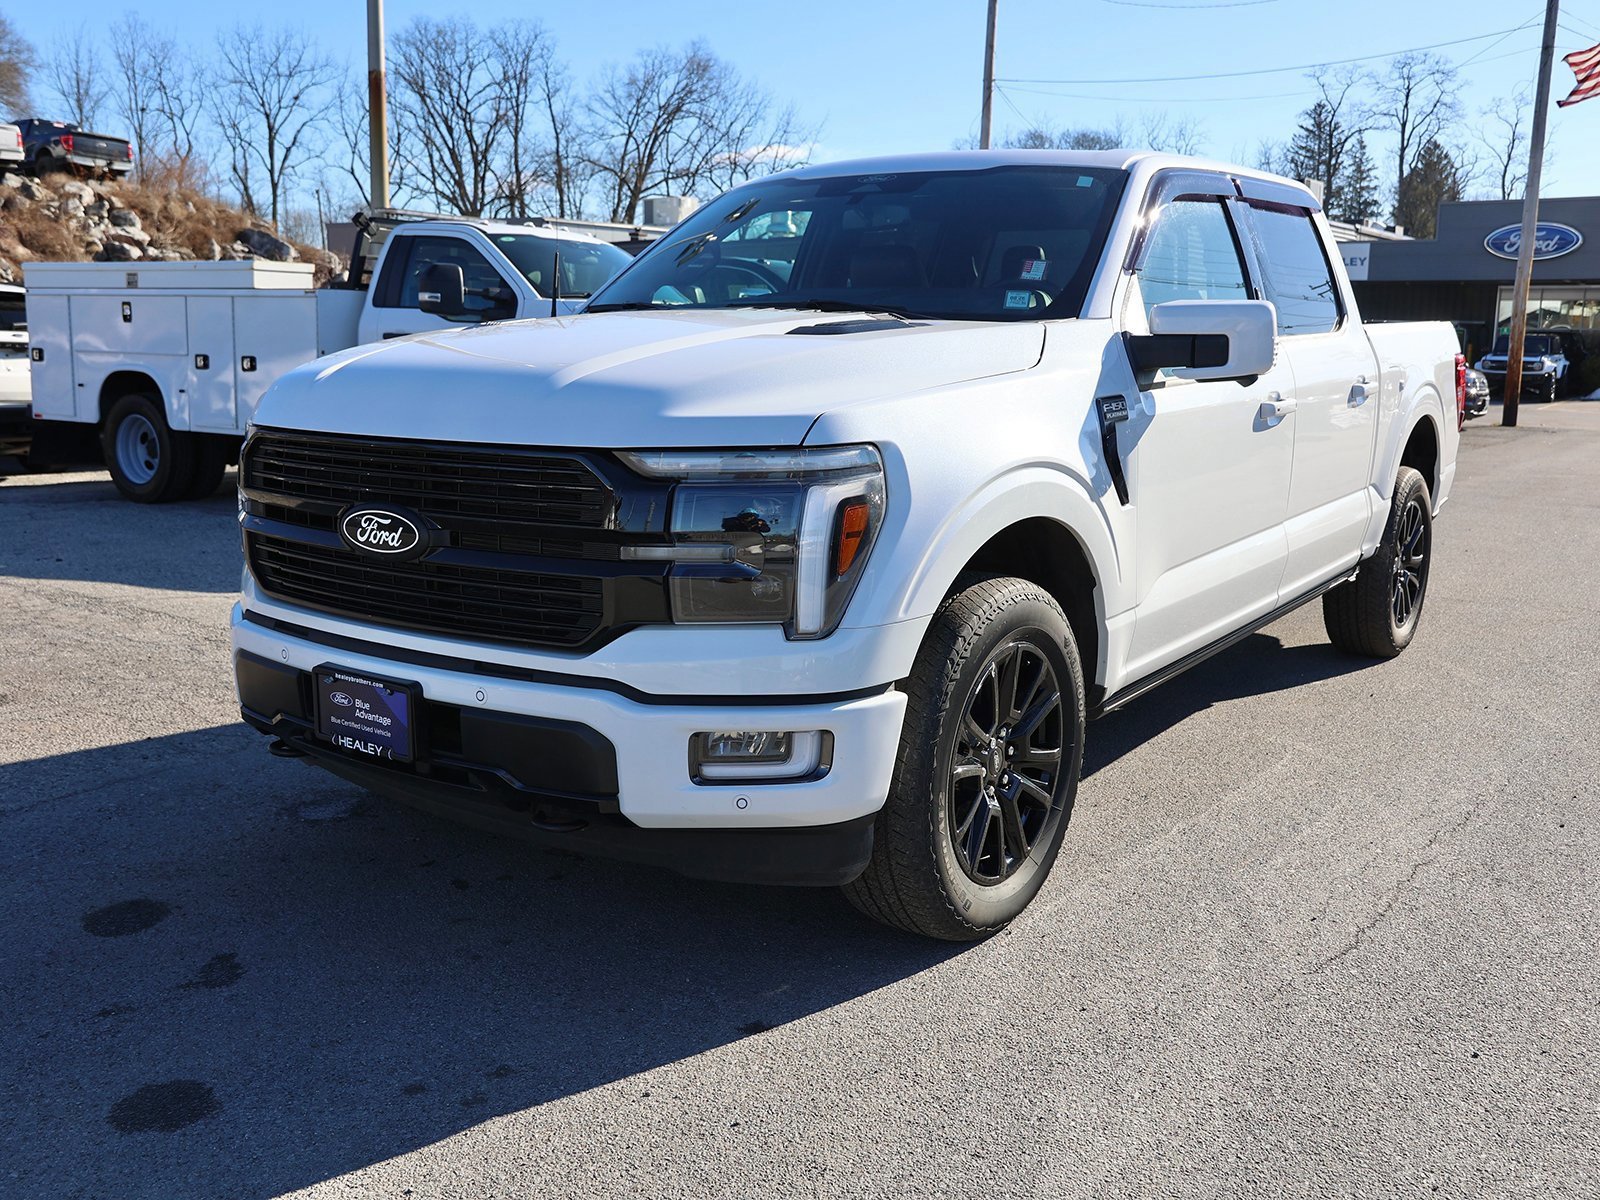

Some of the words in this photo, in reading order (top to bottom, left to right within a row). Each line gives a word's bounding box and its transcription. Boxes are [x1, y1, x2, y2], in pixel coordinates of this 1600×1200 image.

[1504, 231, 1560, 252] Frd
[1104, 400, 1125, 412] F-150
[357, 515, 403, 547] Ford
[334, 673, 384, 688] healeybrothers.com
[334, 693, 348, 705] Ford
[355, 699, 370, 710] Blue
[355, 709, 392, 726] Advantage
[330, 716, 341, 724] Blue
[342, 718, 361, 730] Certified
[362, 722, 373, 733] Used
[374, 725, 391, 738] Vehicle
[338, 735, 382, 756] HEALEY
